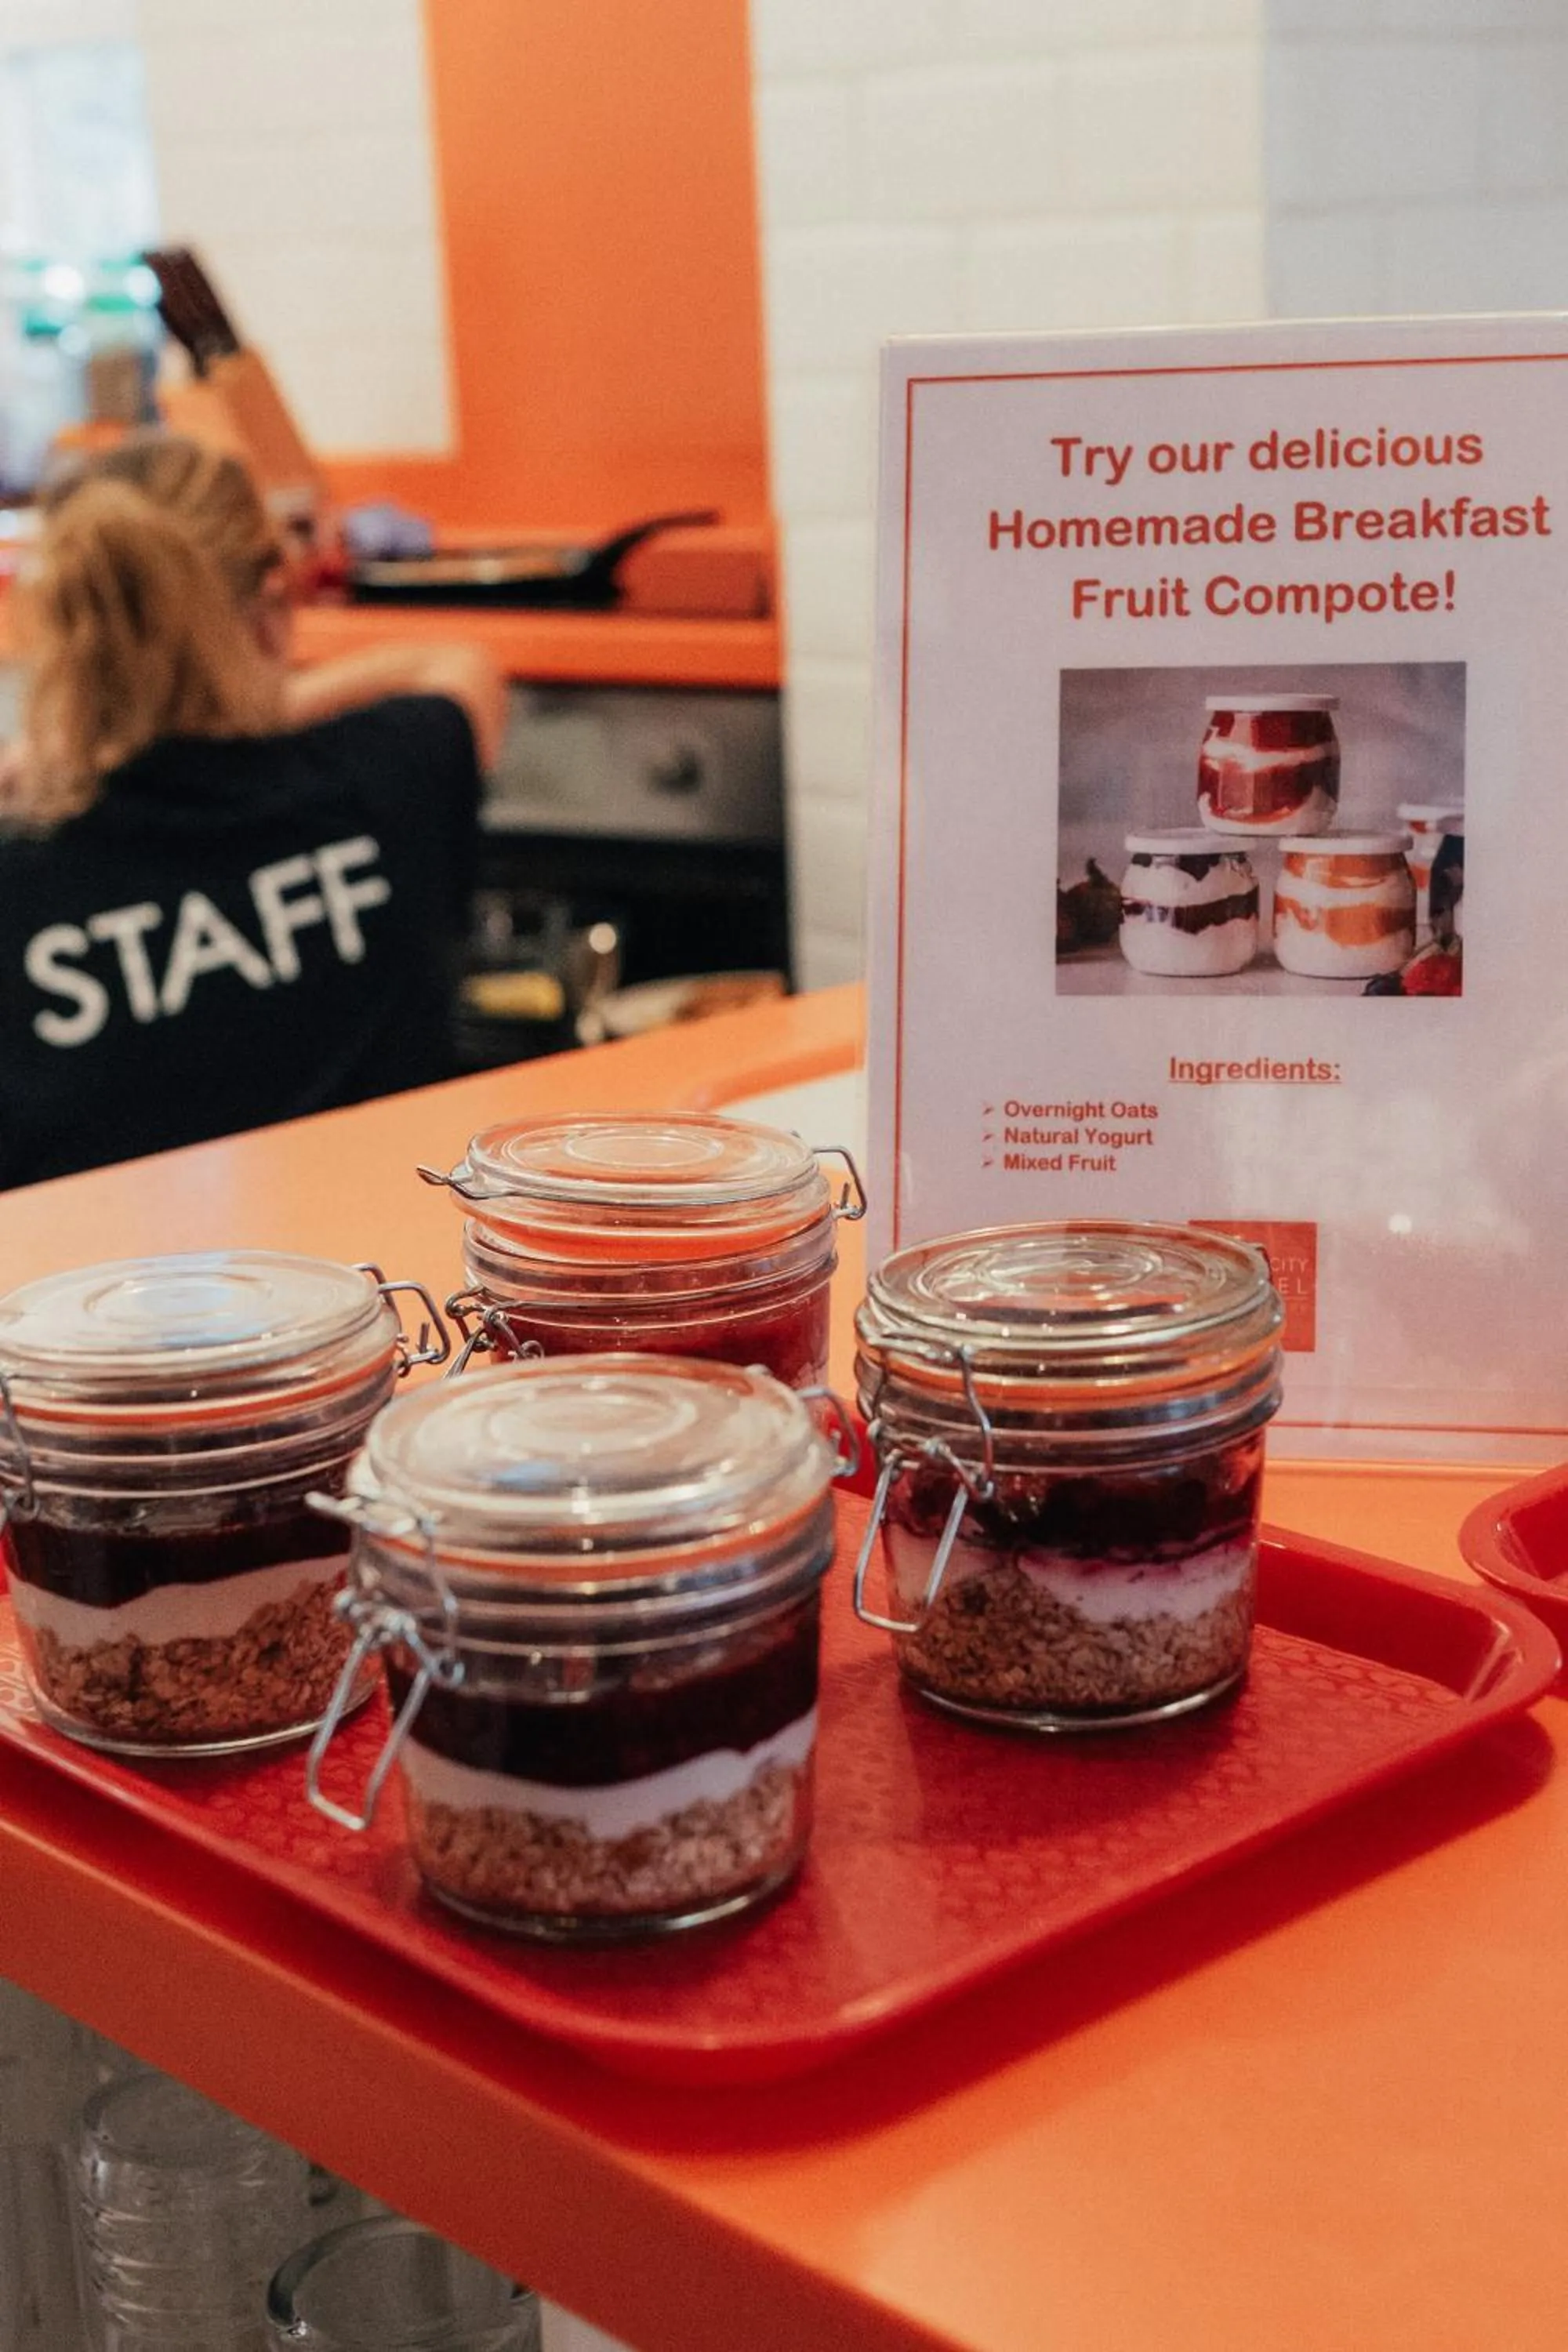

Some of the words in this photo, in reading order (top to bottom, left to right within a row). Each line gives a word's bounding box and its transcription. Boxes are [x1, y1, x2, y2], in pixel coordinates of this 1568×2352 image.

[1050, 436, 1134, 486] Try
[1147, 441, 1234, 474] our
[1247, 427, 1483, 470] delicious
[988, 503, 1276, 550] Homemade
[1294, 495, 1552, 541] Breakfast
[1072, 577, 1191, 619] Fruit
[1204, 571, 1456, 623] Compote!
[24, 834, 391, 1047] STAFF
[1169, 1056, 1341, 1084] Ingredients:
[1004, 1100, 1105, 1122] Overnight
[1111, 1101, 1159, 1119] Oats
[1004, 1127, 1080, 1145] Natural
[1085, 1127, 1154, 1148] Yogurt
[1004, 1154, 1063, 1170] Mixed
[1068, 1153, 1117, 1171] Fruit
